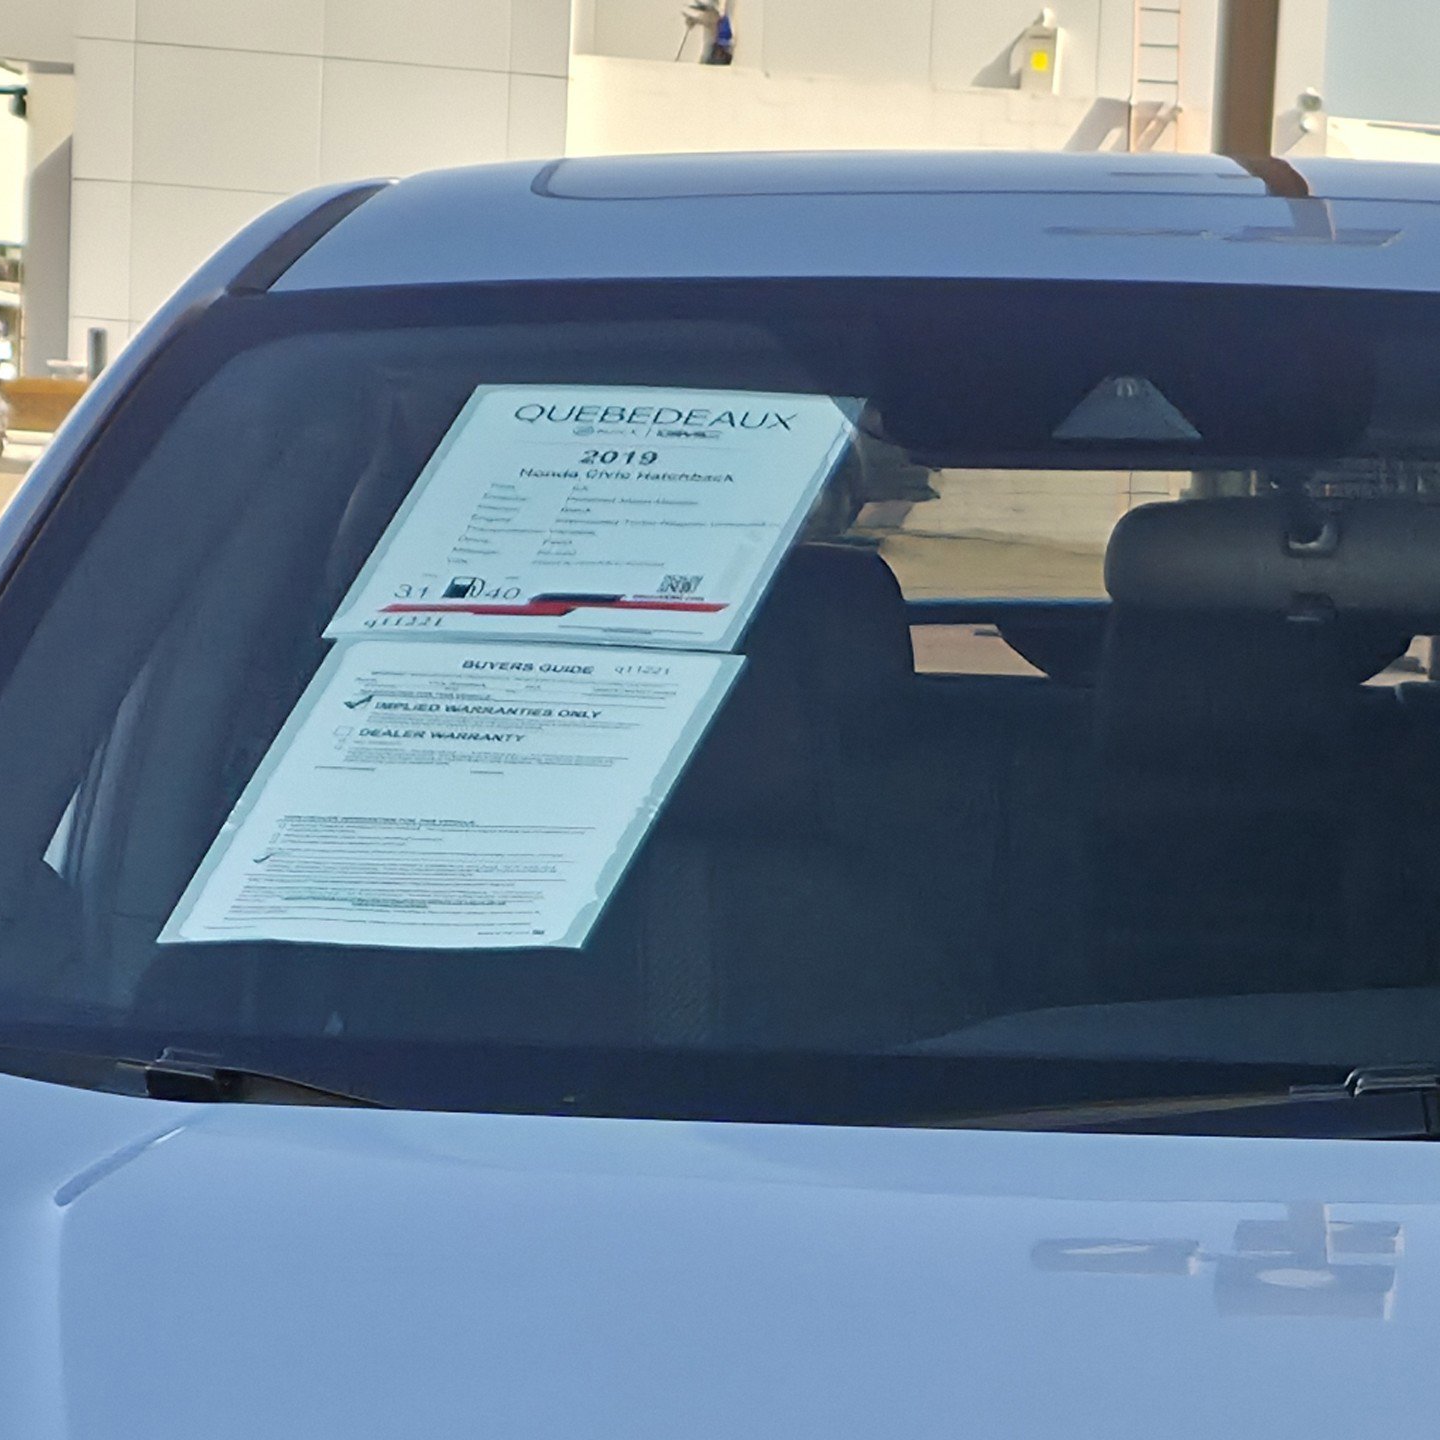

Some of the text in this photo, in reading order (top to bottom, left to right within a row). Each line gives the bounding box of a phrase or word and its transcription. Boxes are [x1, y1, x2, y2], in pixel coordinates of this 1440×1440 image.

[514, 403, 798, 431] QUEBEDEAUX
[579, 449, 659, 466] 2019
[393, 584, 428, 599] 31
[485, 586, 522, 600] 40
[462, 659, 595, 675] BUYERS GUIDE
[374, 701, 602, 720] IMPLIED WARRANTIES ONLY
[358, 728, 527, 743] DEALER WARRANTY
